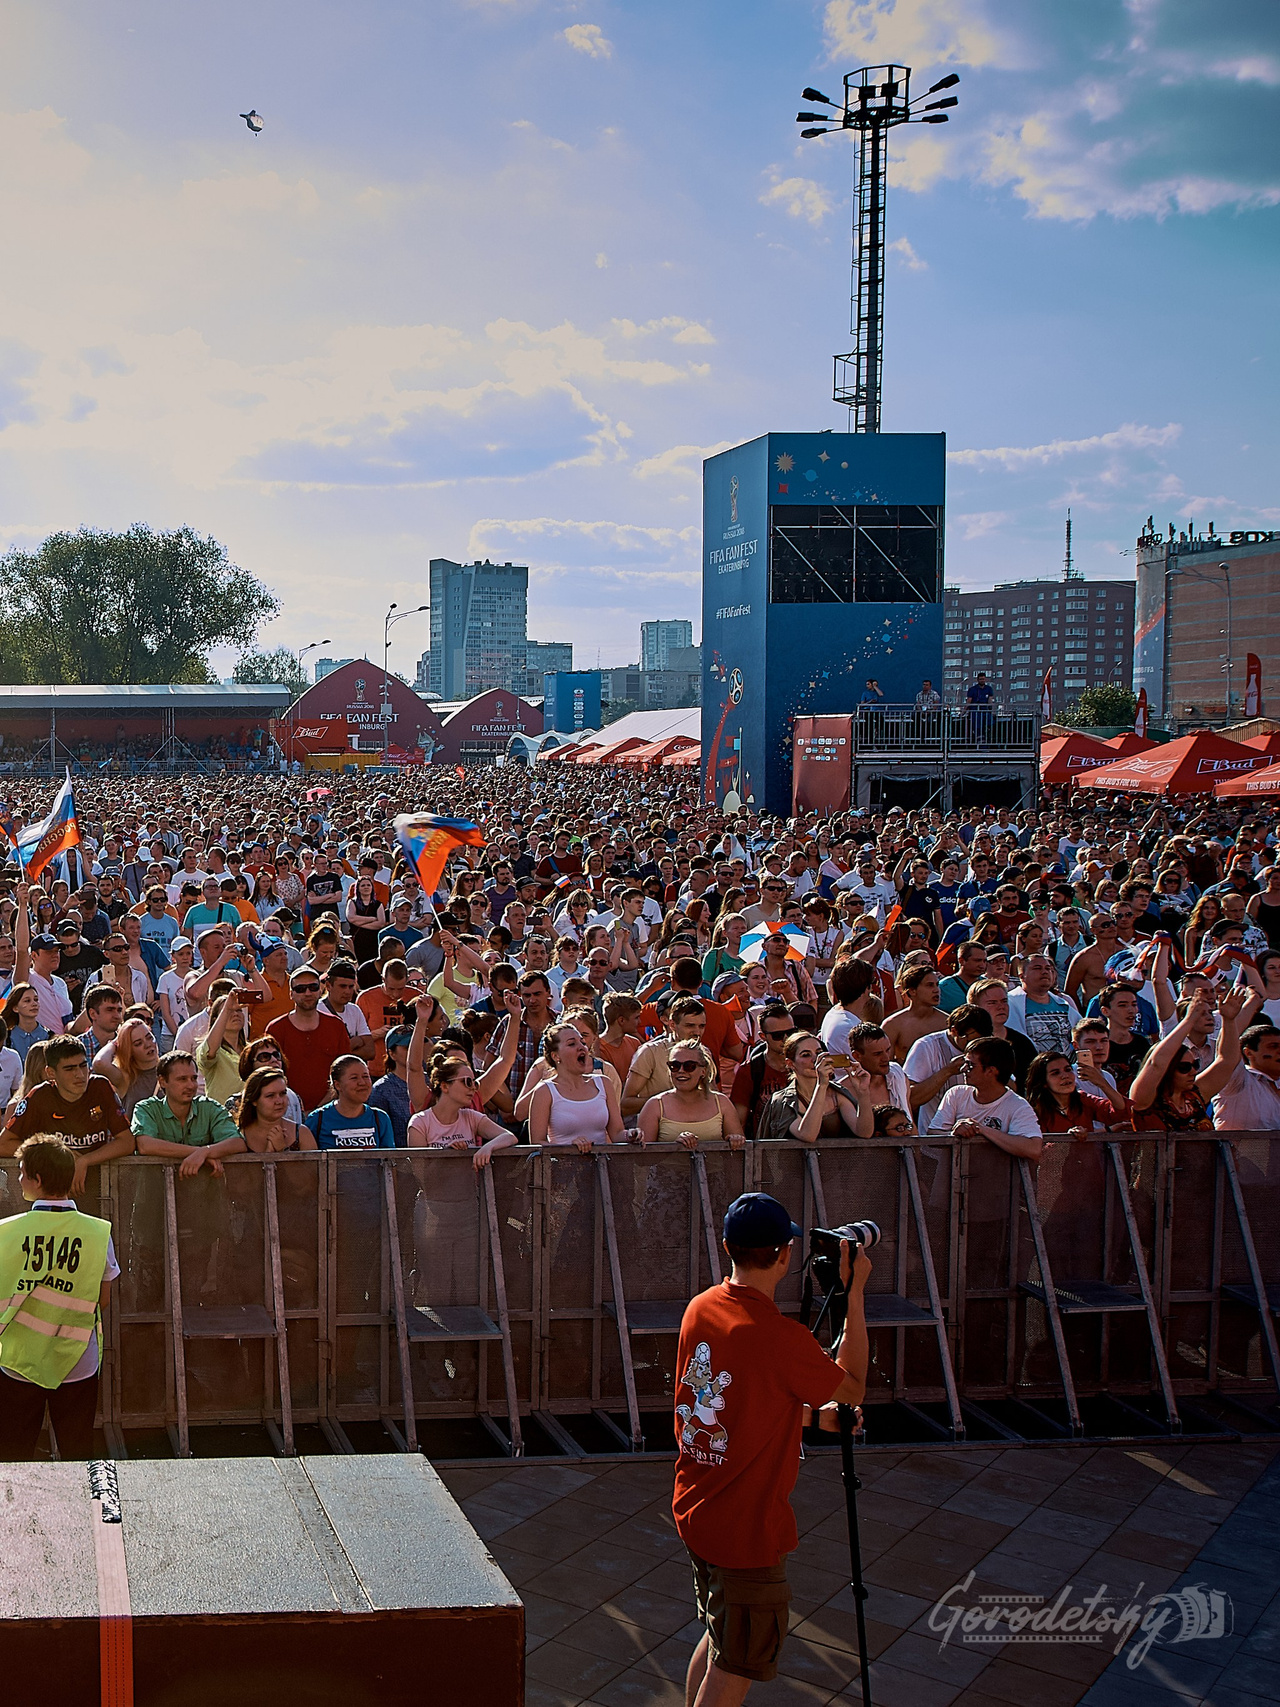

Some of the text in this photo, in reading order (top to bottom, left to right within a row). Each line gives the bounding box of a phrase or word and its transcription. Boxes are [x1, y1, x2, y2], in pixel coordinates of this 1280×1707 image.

[709, 539, 758, 565] FIFA FAN FEST
[718, 558, 750, 575] EKATERINBURG
[716, 604, 751, 620] #FIFAFanFest
[372, 713, 400, 722] FEST
[300, 728, 320, 736] Bud
[1073, 757, 1117, 766] Bud
[1203, 758, 1257, 770] Bud
[1106, 778, 1120, 786] BUD'S
[1129, 780, 1141, 788] YOU
[1246, 782, 1259, 791] THIS
[1260, 781, 1276, 790] BUD'S
[55, 1130, 106, 1147] Rakuten
[335, 1137, 377, 1147] RUSSIA
[22, 1235, 82, 1274] 15146
